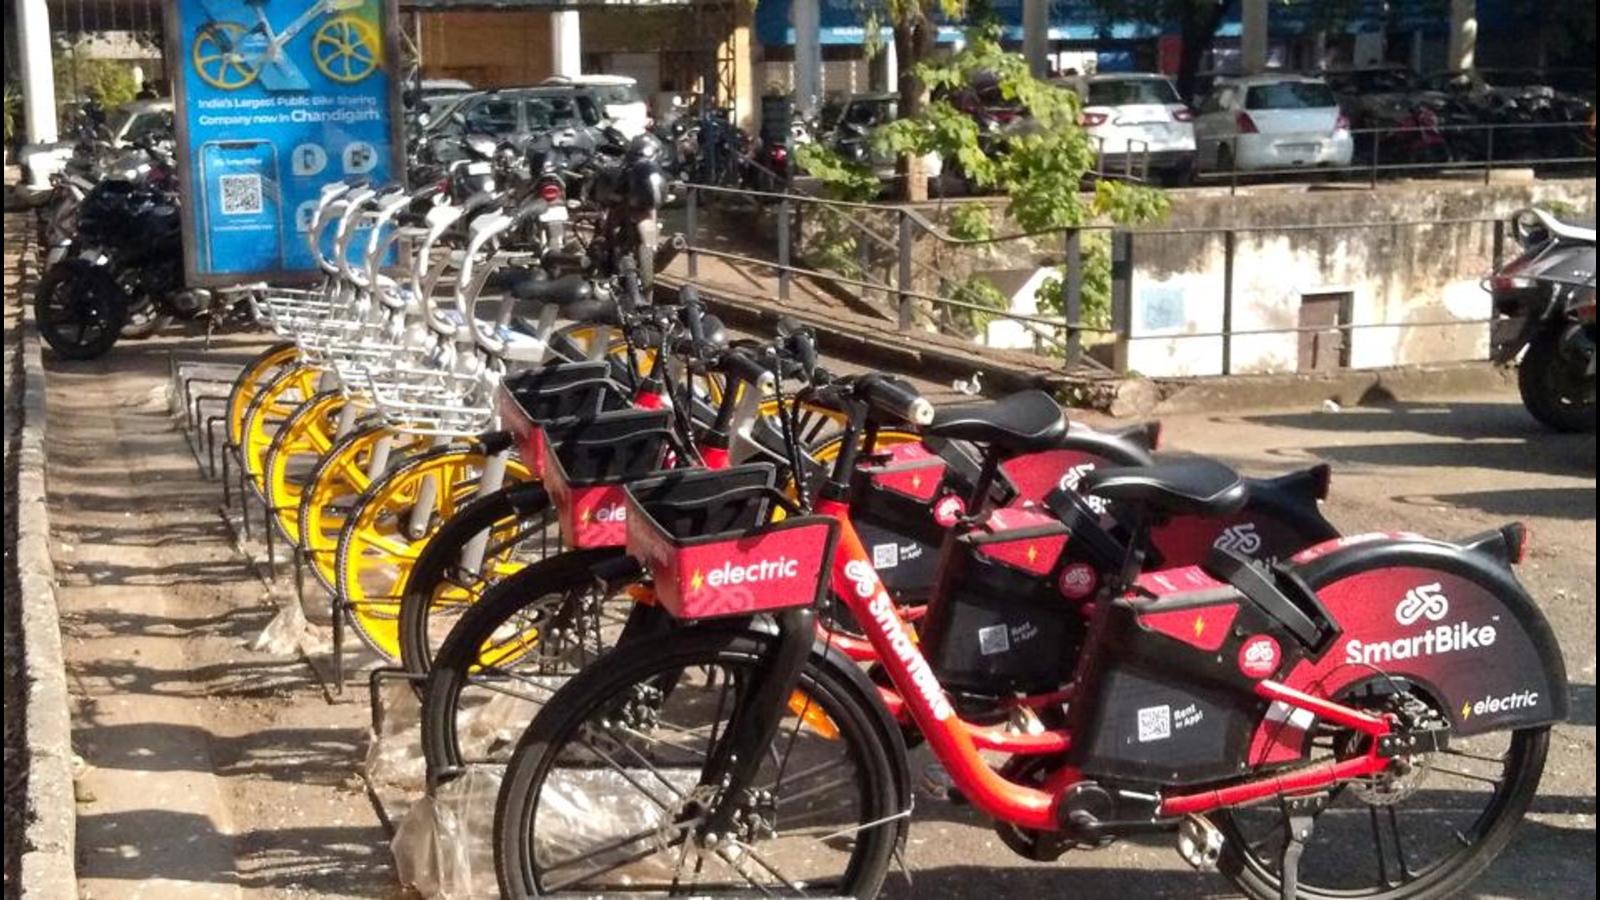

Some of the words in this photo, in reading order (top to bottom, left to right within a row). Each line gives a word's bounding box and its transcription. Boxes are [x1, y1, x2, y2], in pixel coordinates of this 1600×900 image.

[234, 97, 275, 109] Largest
[277, 96, 310, 106] Public
[198, 114, 251, 126] Company
[253, 115, 277, 124] now
[278, 113, 290, 123] in
[291, 108, 380, 124] Chandigarh
[707, 555, 799, 587] electric
[1345, 621, 1497, 664] SmartBike
[869, 591, 953, 721] SmartBike
[1174, 703, 1195, 720] Rent
[1473, 689, 1539, 715] electric
[1184, 709, 1203, 727] App!
